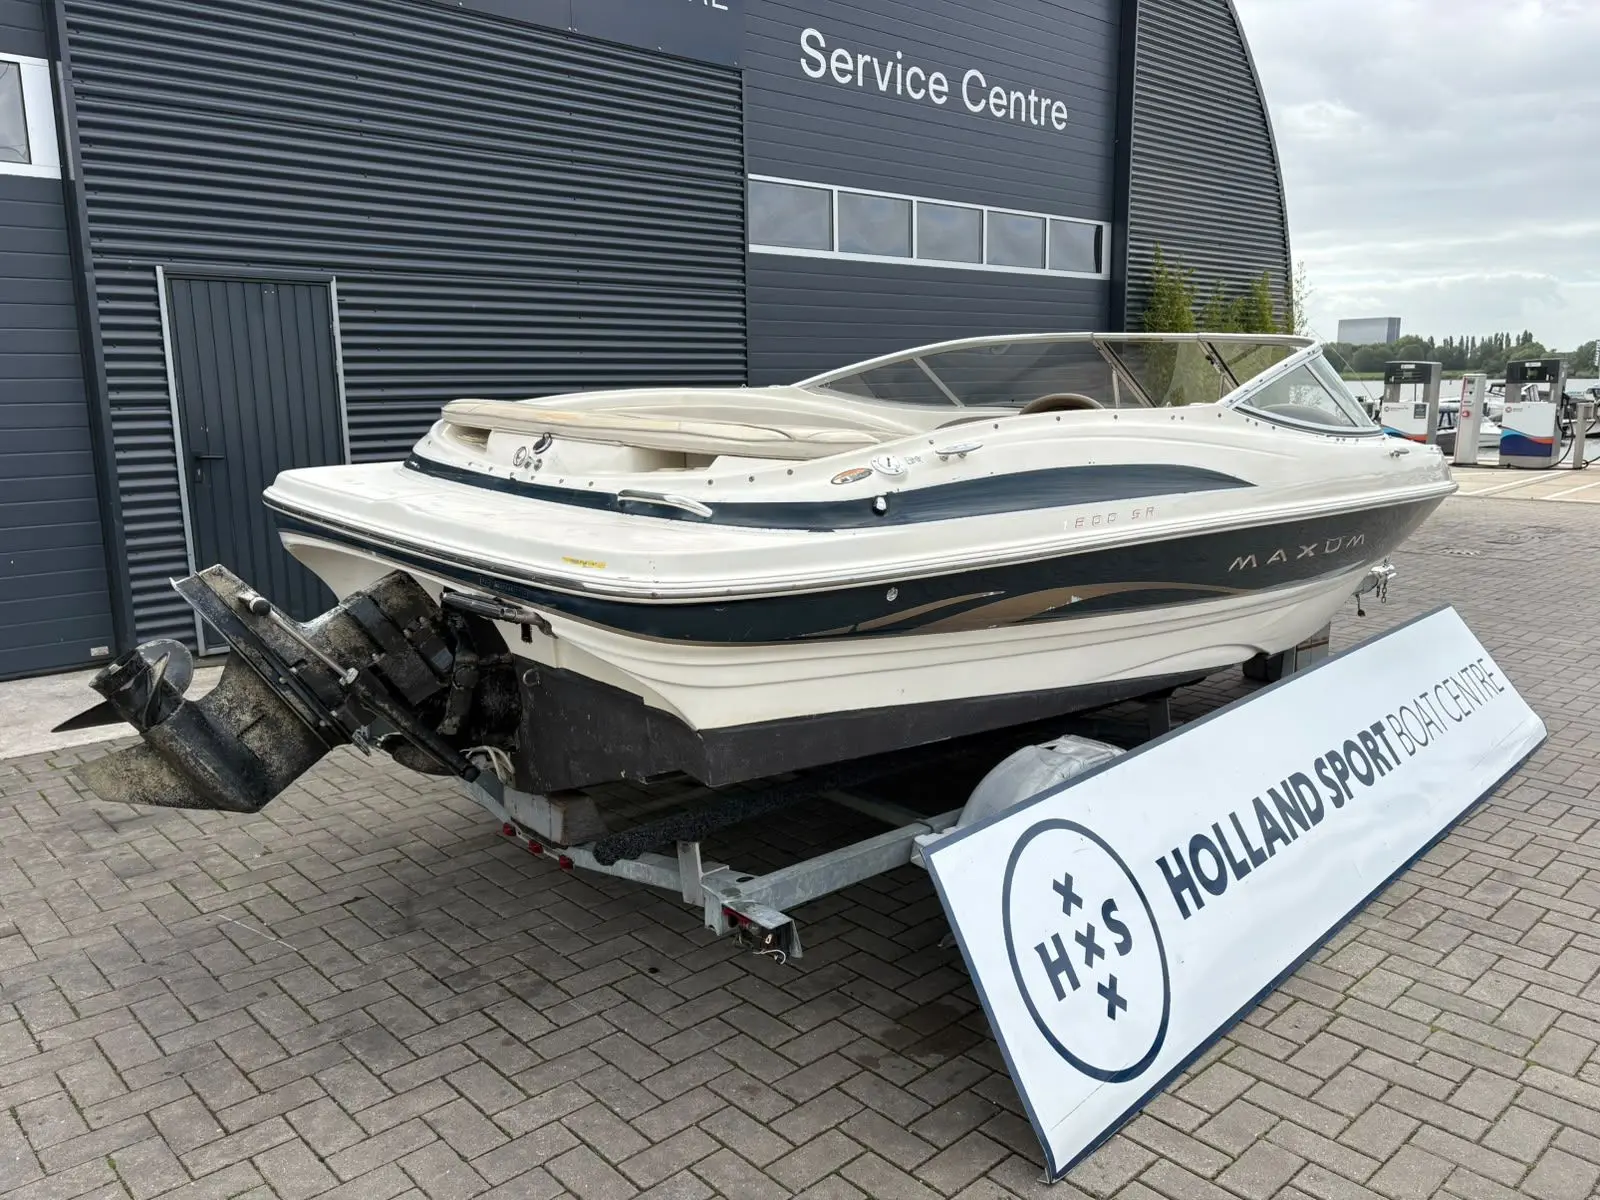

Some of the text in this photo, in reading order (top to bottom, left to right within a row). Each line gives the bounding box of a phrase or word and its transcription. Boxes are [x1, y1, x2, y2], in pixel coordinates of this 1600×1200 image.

[800, 28, 1068, 131] Service Centre
[1155, 658, 1505, 920] HOLLAND SPORT BOAT CENTRE
